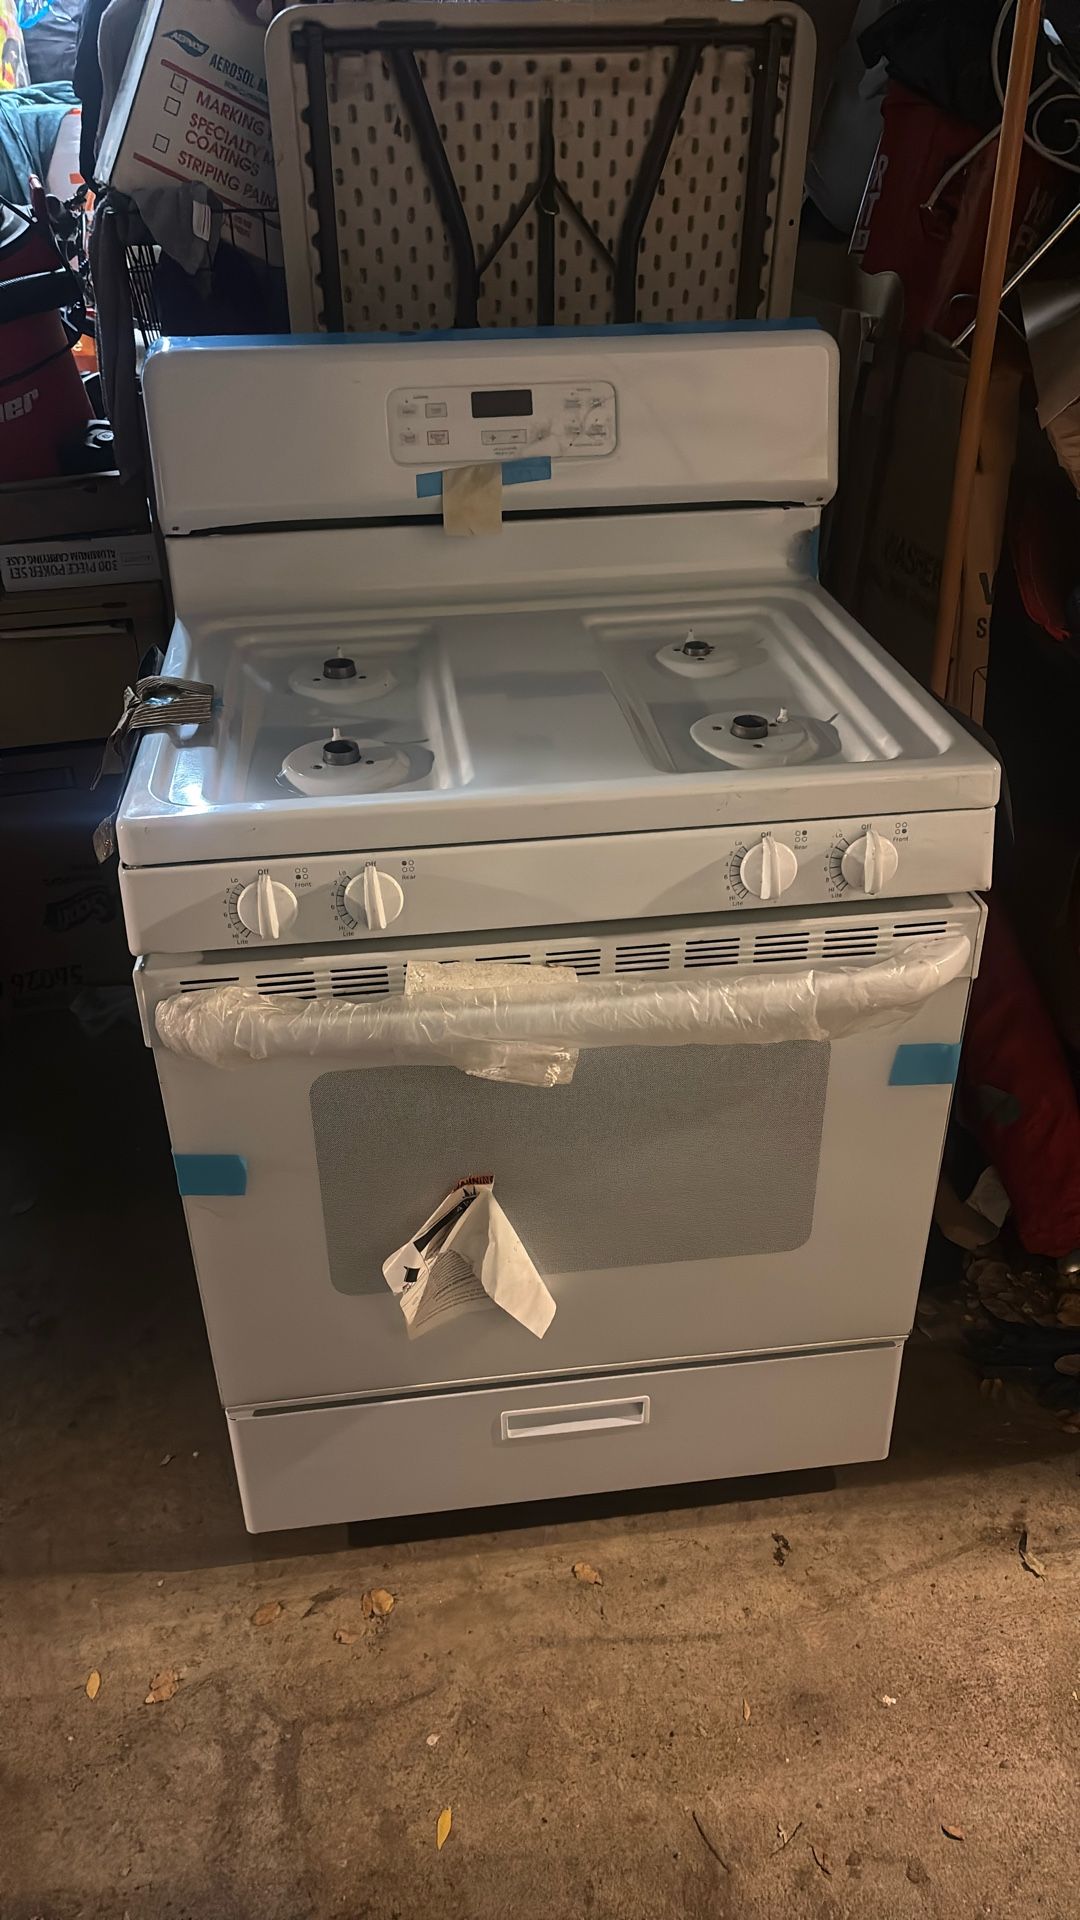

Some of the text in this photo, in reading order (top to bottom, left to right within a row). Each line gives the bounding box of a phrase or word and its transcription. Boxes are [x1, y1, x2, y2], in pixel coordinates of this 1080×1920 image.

[209, 54, 254, 88] AEROSOL
[196, 90, 264, 136] MARKING
[189, 113, 261, 156] SPECIALTY
[186, 130, 260, 177] COATINGS
[178, 151, 241, 191] STRIPING
[6, 555, 27, 566] CASE
[27, 552, 69, 564] CARRYING
[70, 549, 116, 561] ALUMINUM
[30, 564, 65, 578] POKER
[68, 562, 96, 575] PIECE
[98, 560, 118, 572] 300
[10, 567, 30, 580] SET
